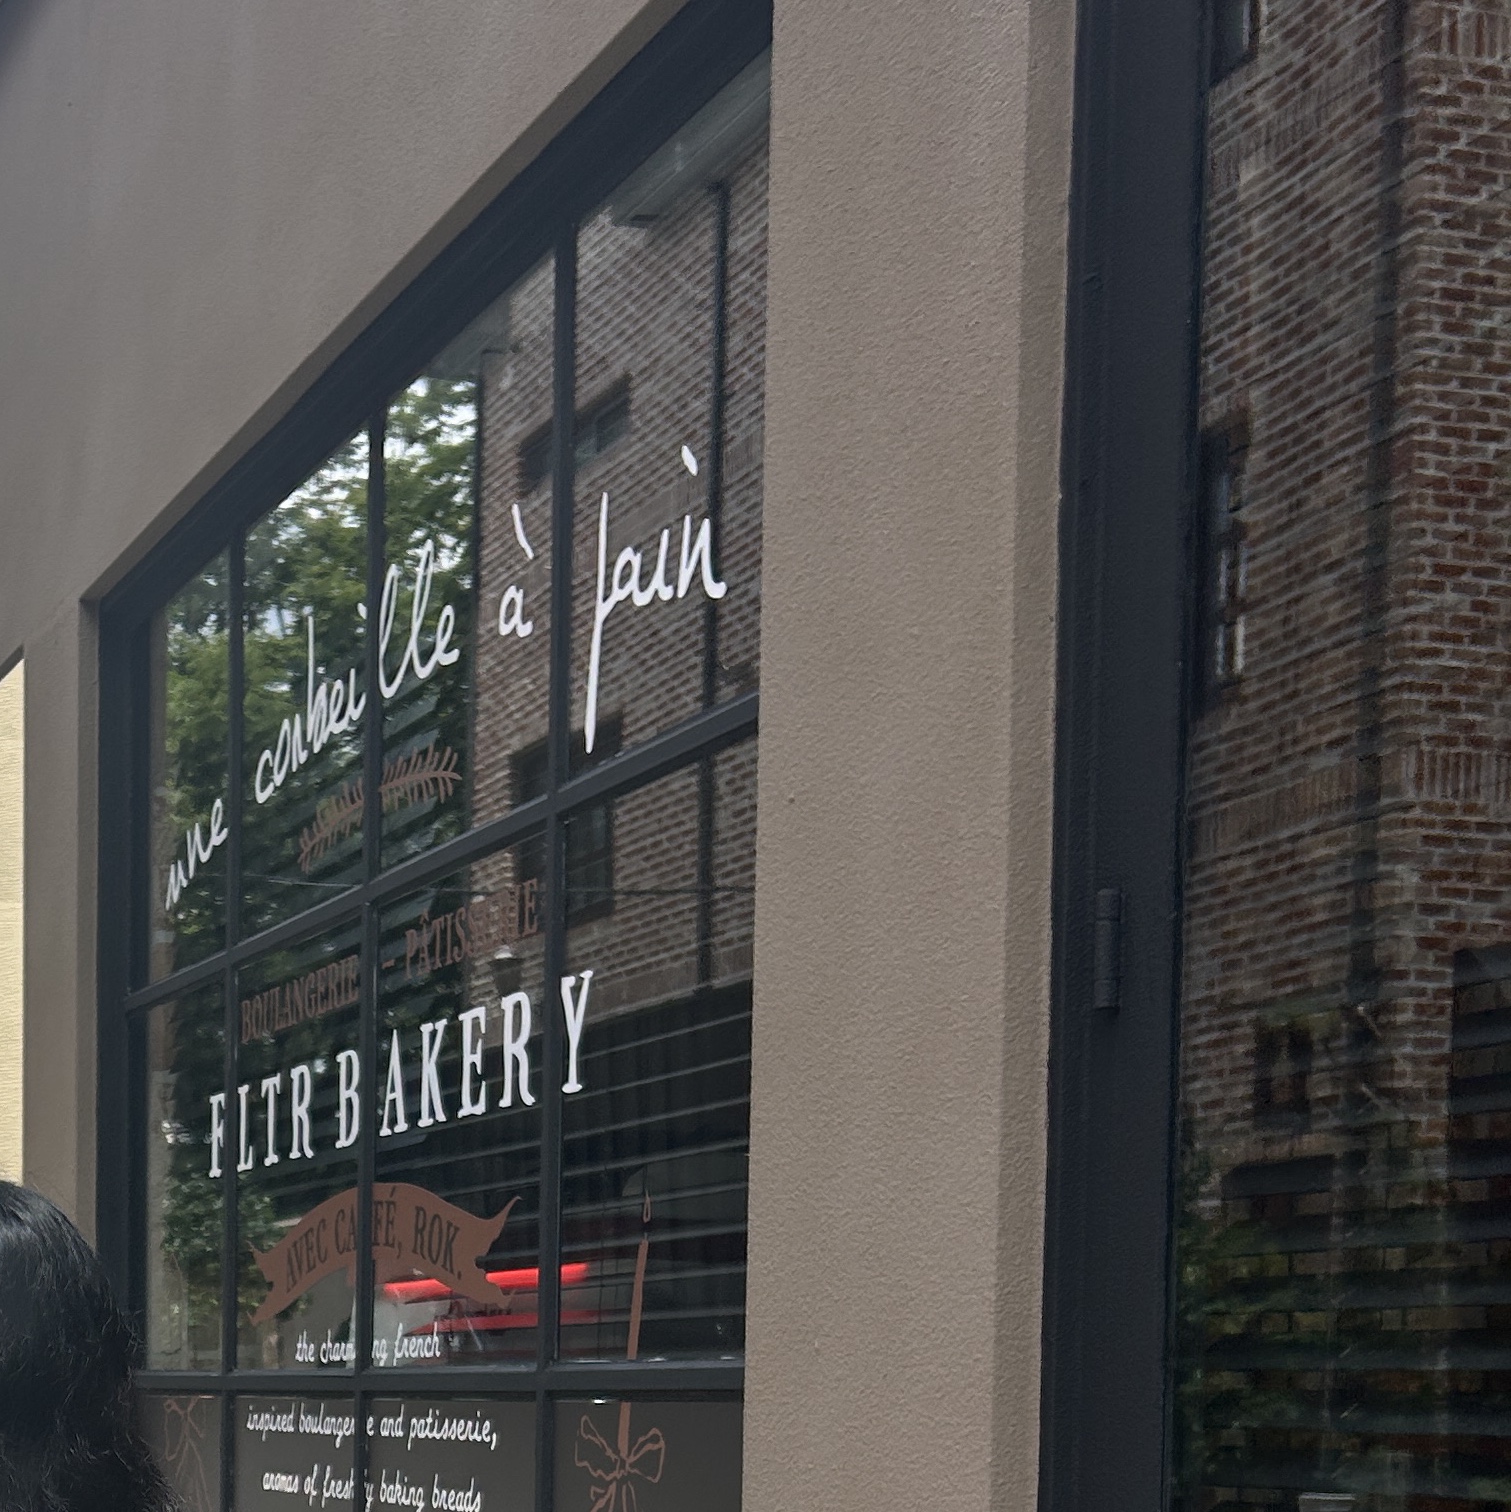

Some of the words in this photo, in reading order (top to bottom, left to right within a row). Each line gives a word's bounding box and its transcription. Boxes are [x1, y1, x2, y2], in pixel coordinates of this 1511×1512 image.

[499, 503, 534, 637] à
[241, 954, 358, 1045] BOULANGERIE
[208, 1063, 314, 1178] FLTR
[335, 970, 593, 1149] BAKERY
[287, 1219, 328, 1293] AVEC
[411, 1205, 462, 1281] ROK.
[295, 1329, 315, 1363] the
[319, 1328, 388, 1367] charmng
[393, 1322, 440, 1367] french
[246, 1402, 294, 1442] inspired
[379, 1404, 404, 1437] and
[407, 1409, 496, 1451] patisserie,
[304, 1463, 317, 1507] of
